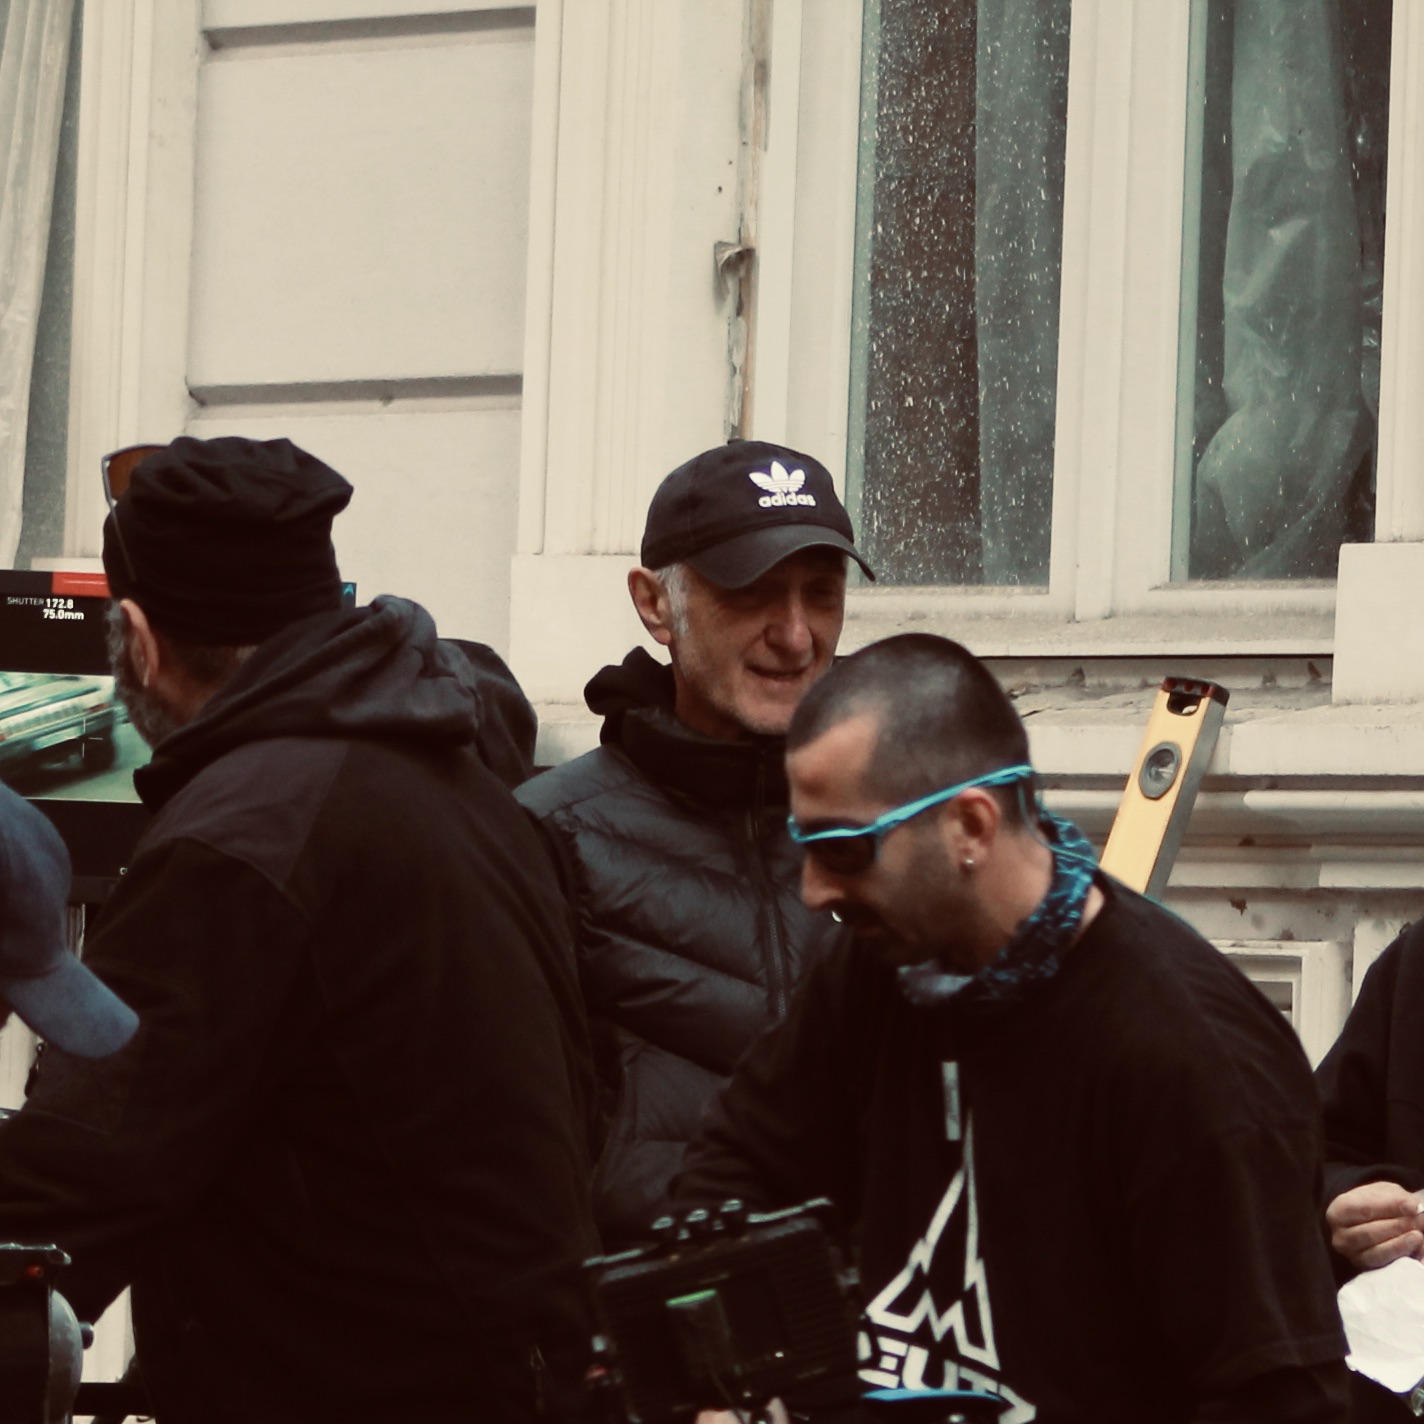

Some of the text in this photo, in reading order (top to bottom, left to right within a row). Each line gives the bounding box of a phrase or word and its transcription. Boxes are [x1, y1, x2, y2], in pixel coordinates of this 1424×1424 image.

[758, 493, 817, 508] adidas
[6, 596, 74, 609] SHUTTER 172.8
[42, 608, 84, 620] 75.0mm
